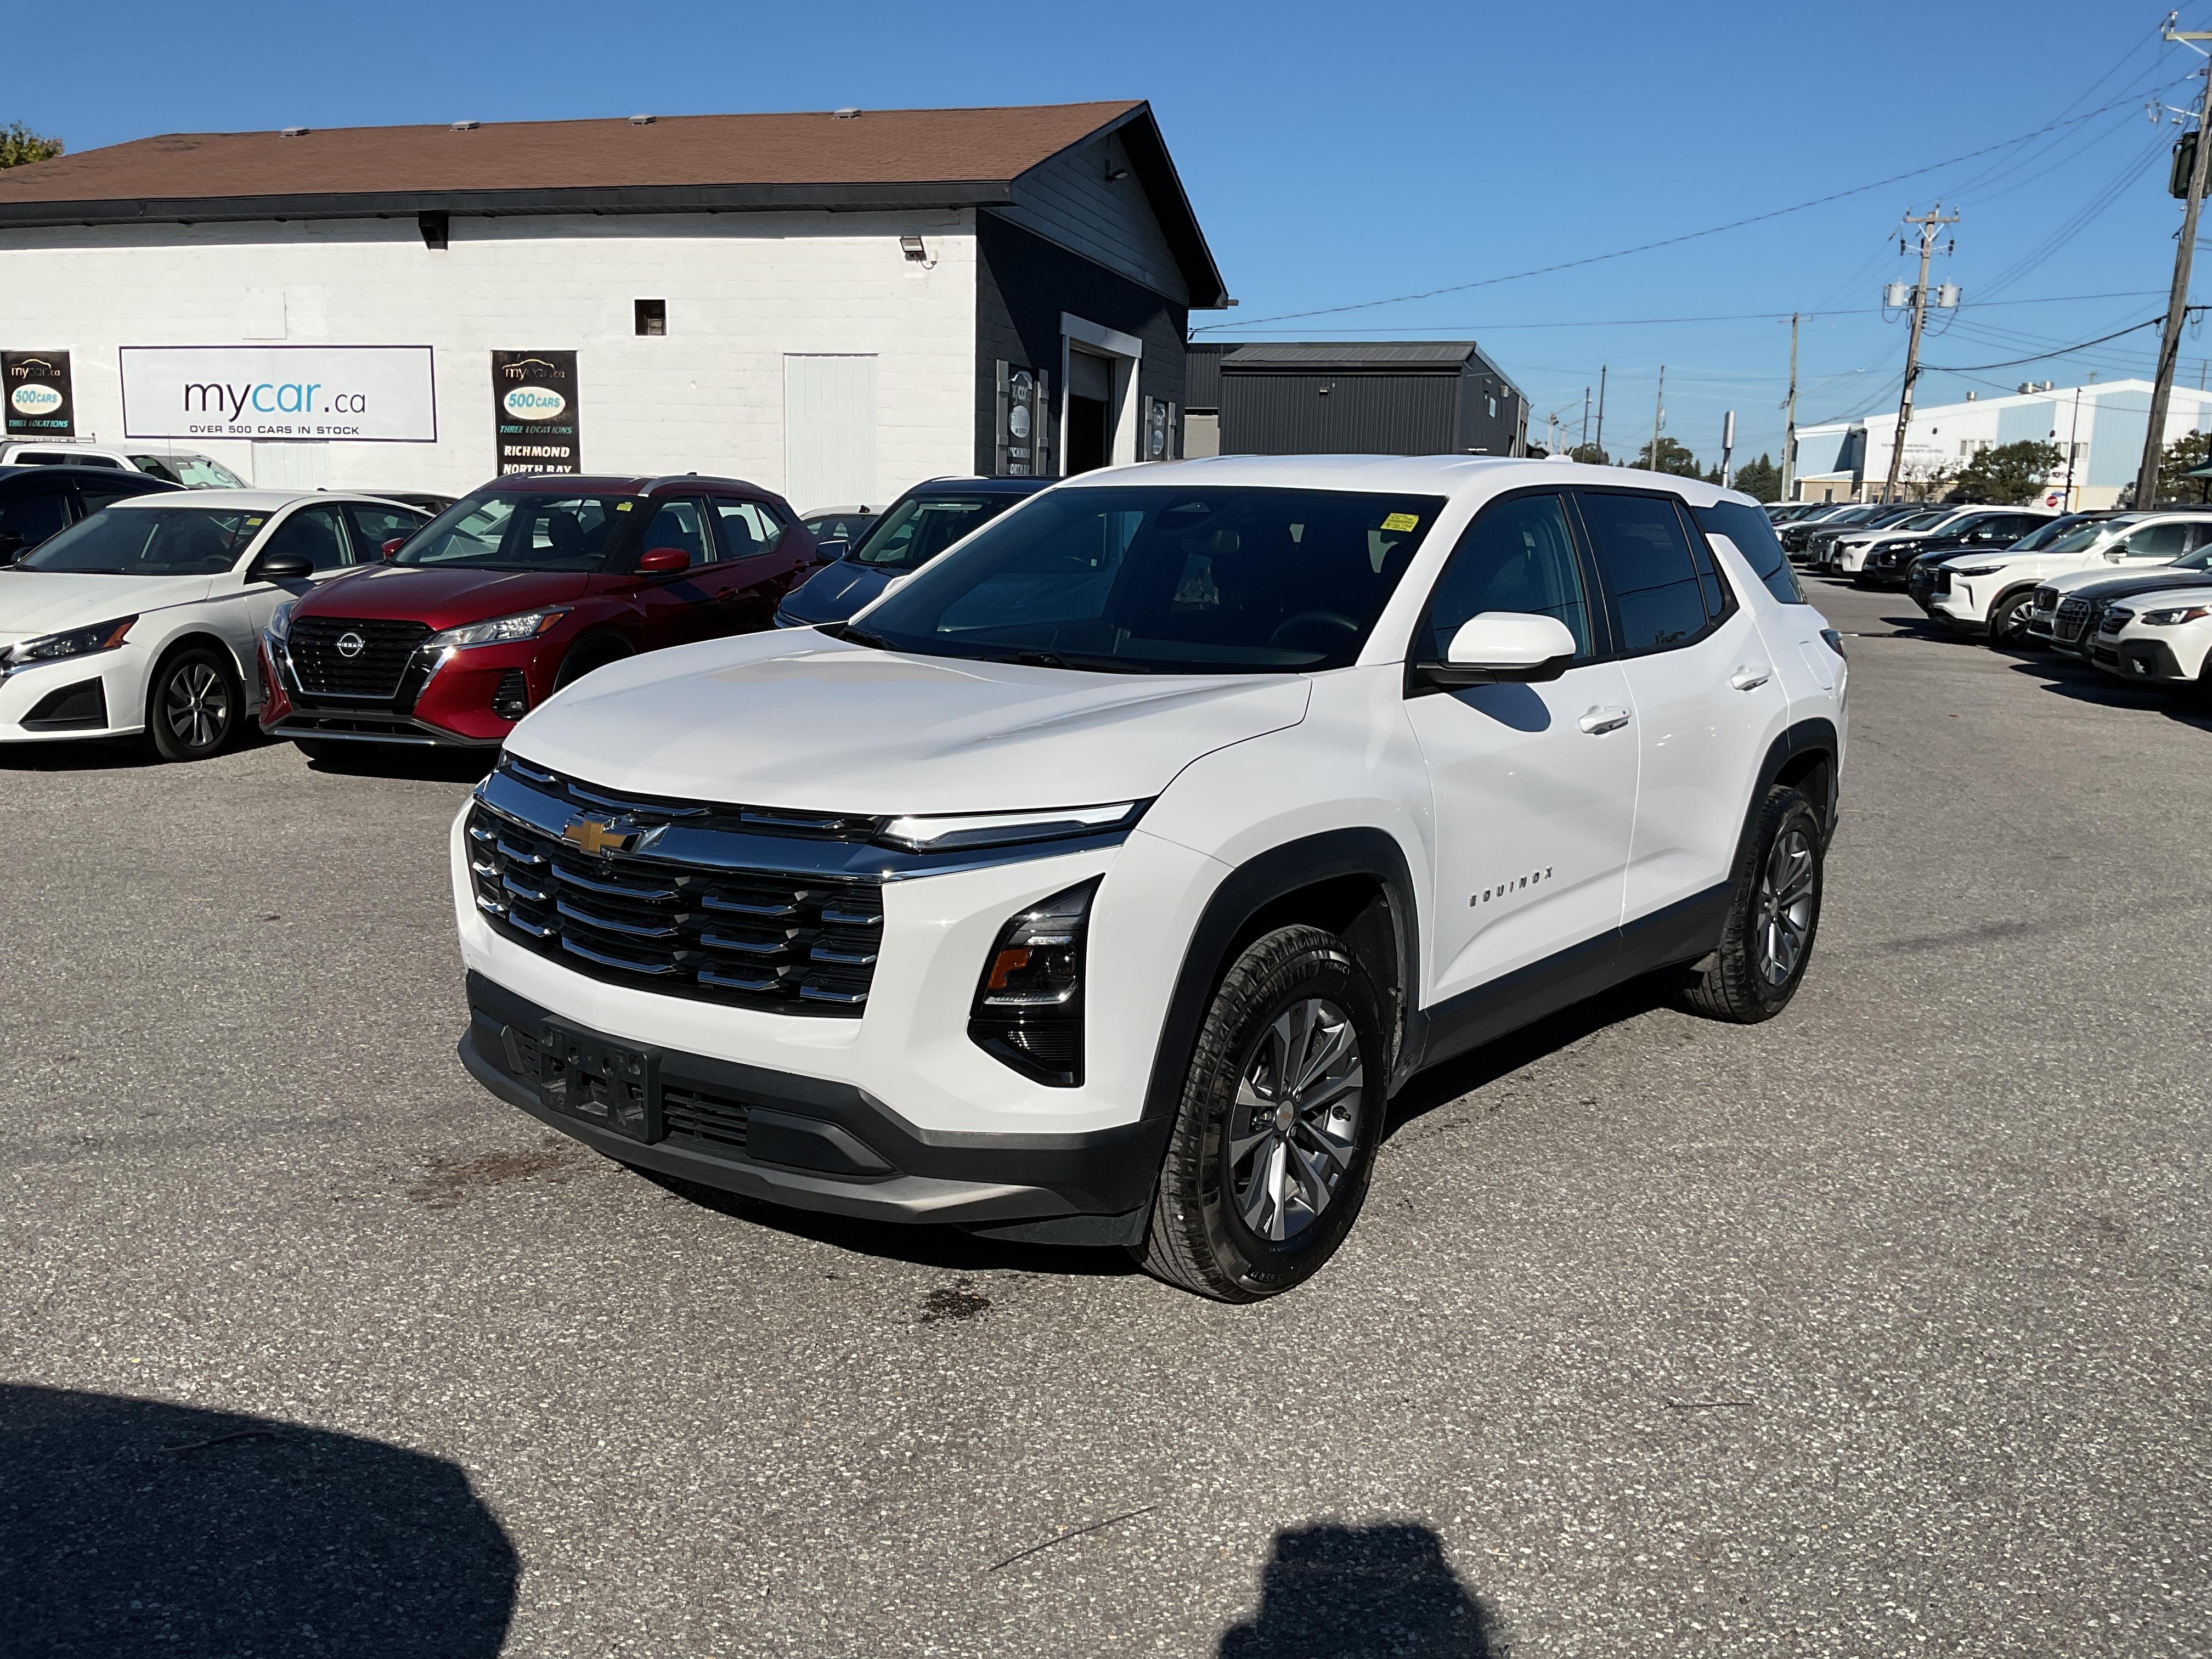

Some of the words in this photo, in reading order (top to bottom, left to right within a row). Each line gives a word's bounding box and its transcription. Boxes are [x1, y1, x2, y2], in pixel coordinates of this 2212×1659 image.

[15, 390, 36, 404] 500
[36, 393, 58, 403] CARS
[184, 383, 366, 422] mycar.ca
[508, 393, 535, 408] 500
[535, 397, 561, 408] CARS
[228, 425, 251, 433] 500
[298, 426, 311, 434] IN
[317, 426, 360, 435] STOCK
[500, 425, 523, 433] THREE
[525, 426, 573, 435] LOCATIONS
[504, 445, 570, 458] RICHMOND
[503, 464, 543, 475] NORTH
[546, 465, 572, 473] BAY
[1468, 865, 1553, 907] EQUINOX
